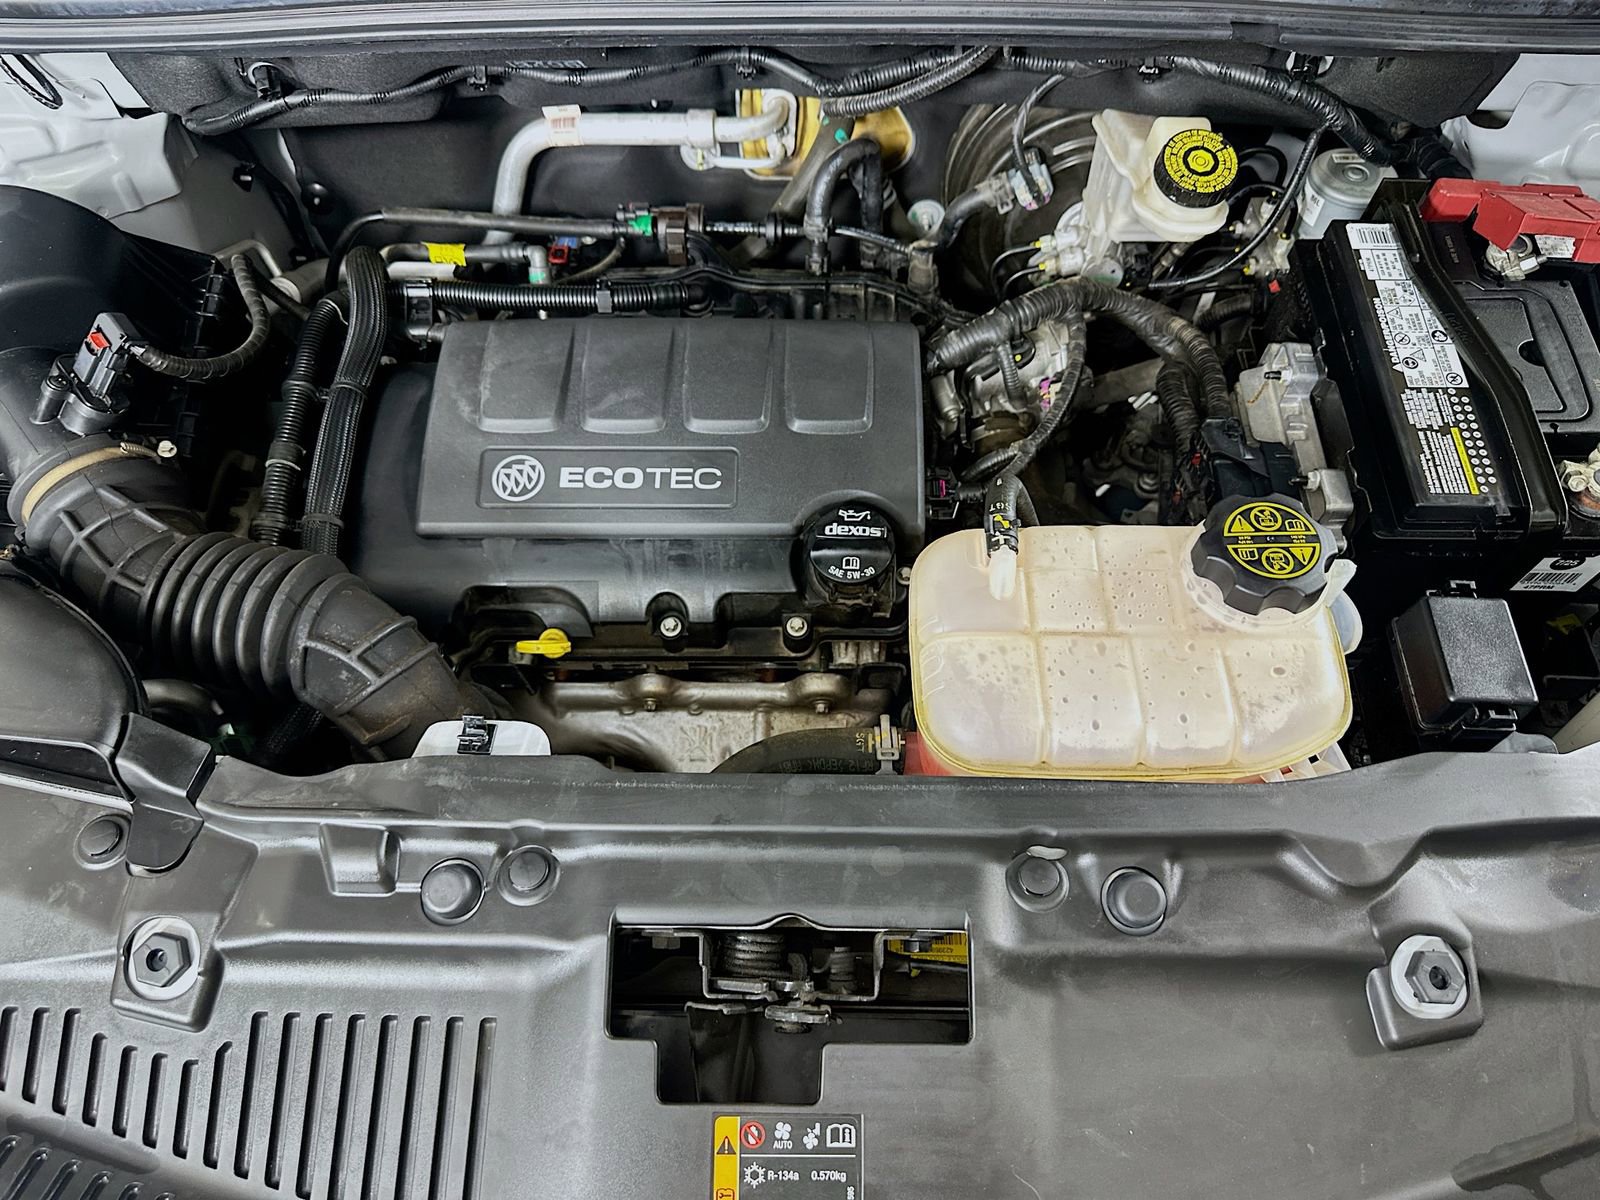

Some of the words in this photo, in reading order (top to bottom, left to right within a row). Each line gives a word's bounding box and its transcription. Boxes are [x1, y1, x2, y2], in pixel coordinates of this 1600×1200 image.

[559, 467, 723, 491] ECOTEC
[828, 565, 845, 578] SAE
[846, 566, 876, 579] 5W-30
[773, 1140, 793, 1149] AUTO
[767, 1170, 799, 1181] R-134a
[811, 1170, 847, 1182] 0.570kg
